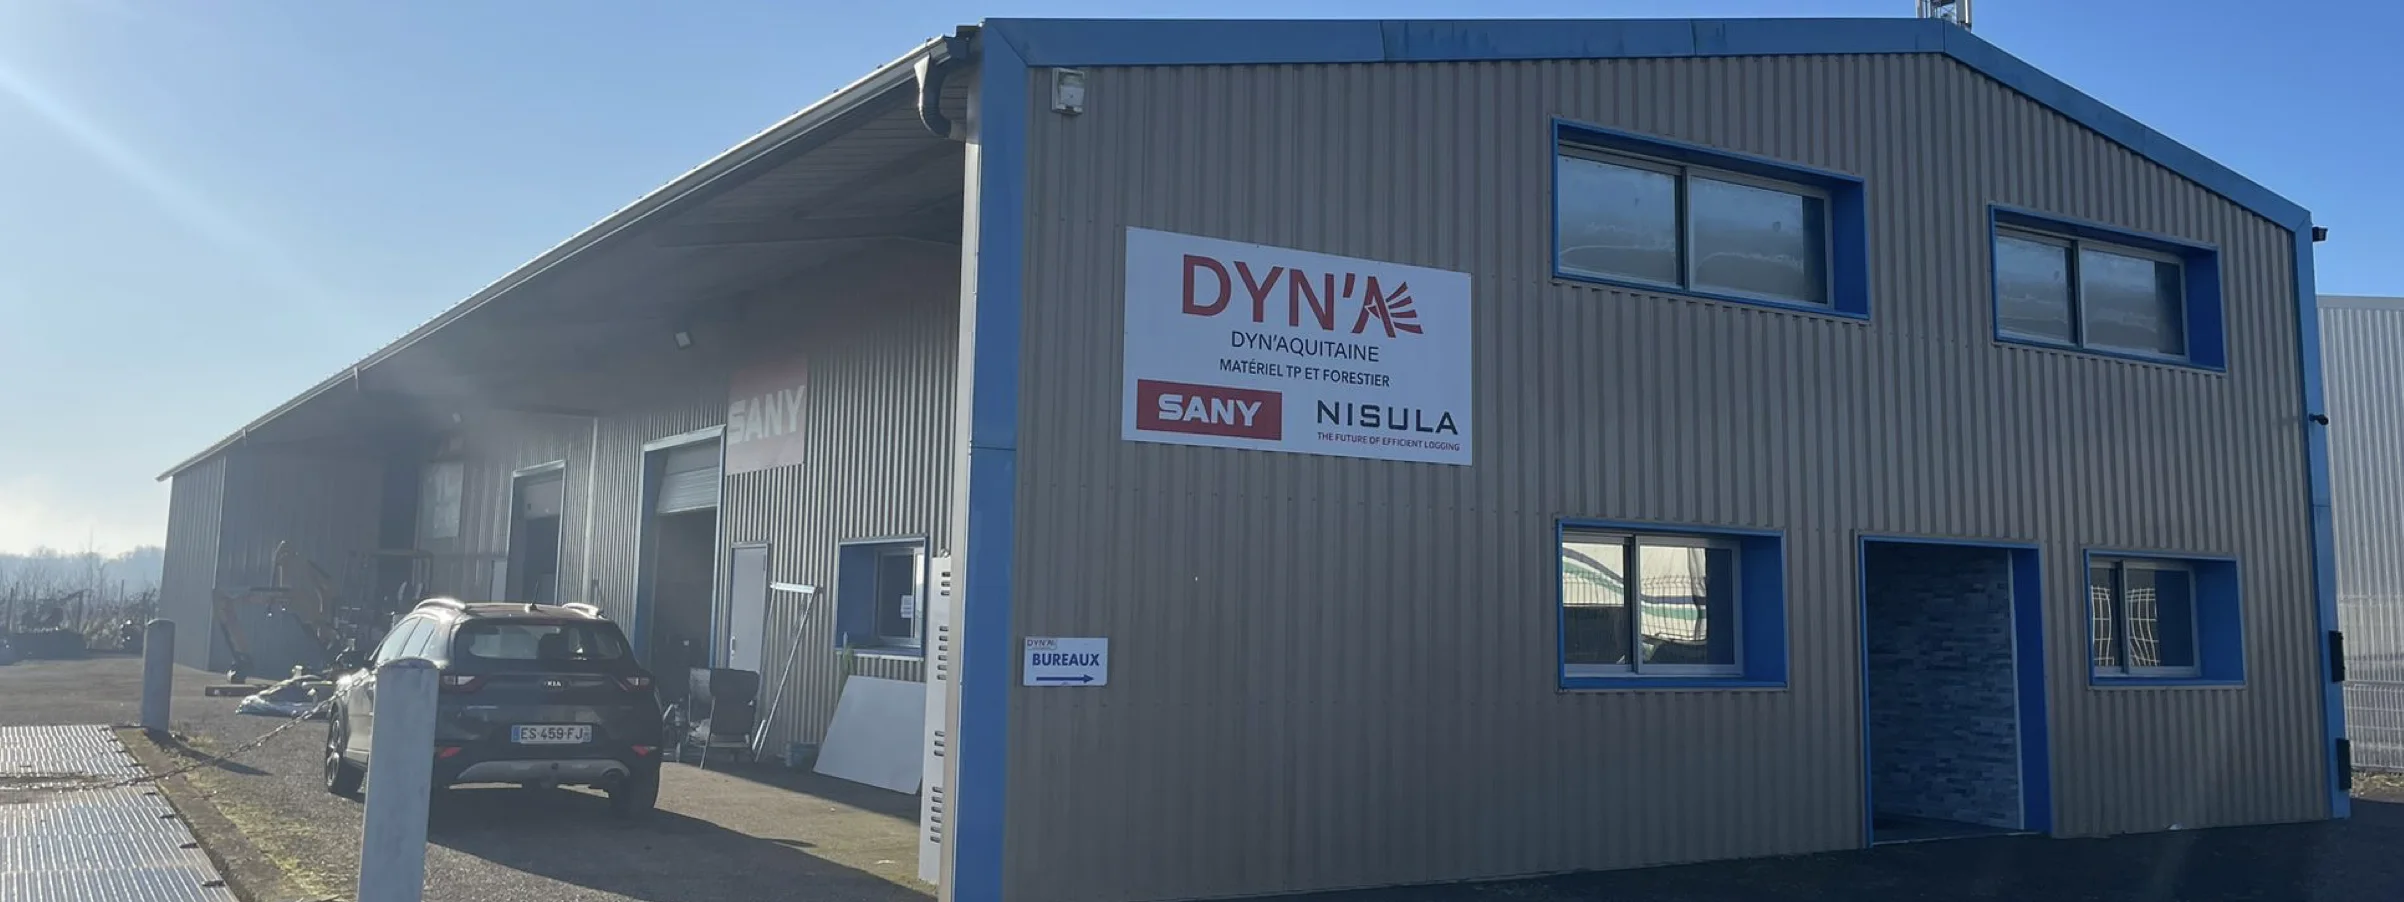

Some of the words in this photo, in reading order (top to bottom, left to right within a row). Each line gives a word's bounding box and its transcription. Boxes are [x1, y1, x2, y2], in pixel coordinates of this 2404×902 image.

[1182, 253, 1397, 338] DYN'A
[1231, 331, 1379, 362] DYN'AQUITAINE
[1219, 358, 1283, 377] MATÉRIEL
[1286, 365, 1301, 378] TP
[1305, 367, 1320, 380] ET
[1323, 369, 1390, 387] FORESTIER
[727, 385, 805, 446] SANY
[1158, 394, 1262, 426] SANY
[1317, 400, 1458, 435] NISULA
[1317, 432, 1334, 441] THE
[1335, 433, 1367, 443] FUTURE
[1369, 436, 1380, 445] OF
[1382, 437, 1422, 448] EFFICIENT
[1424, 441, 1460, 451] LOGGING
[1032, 653, 1100, 667] BUREAUX
